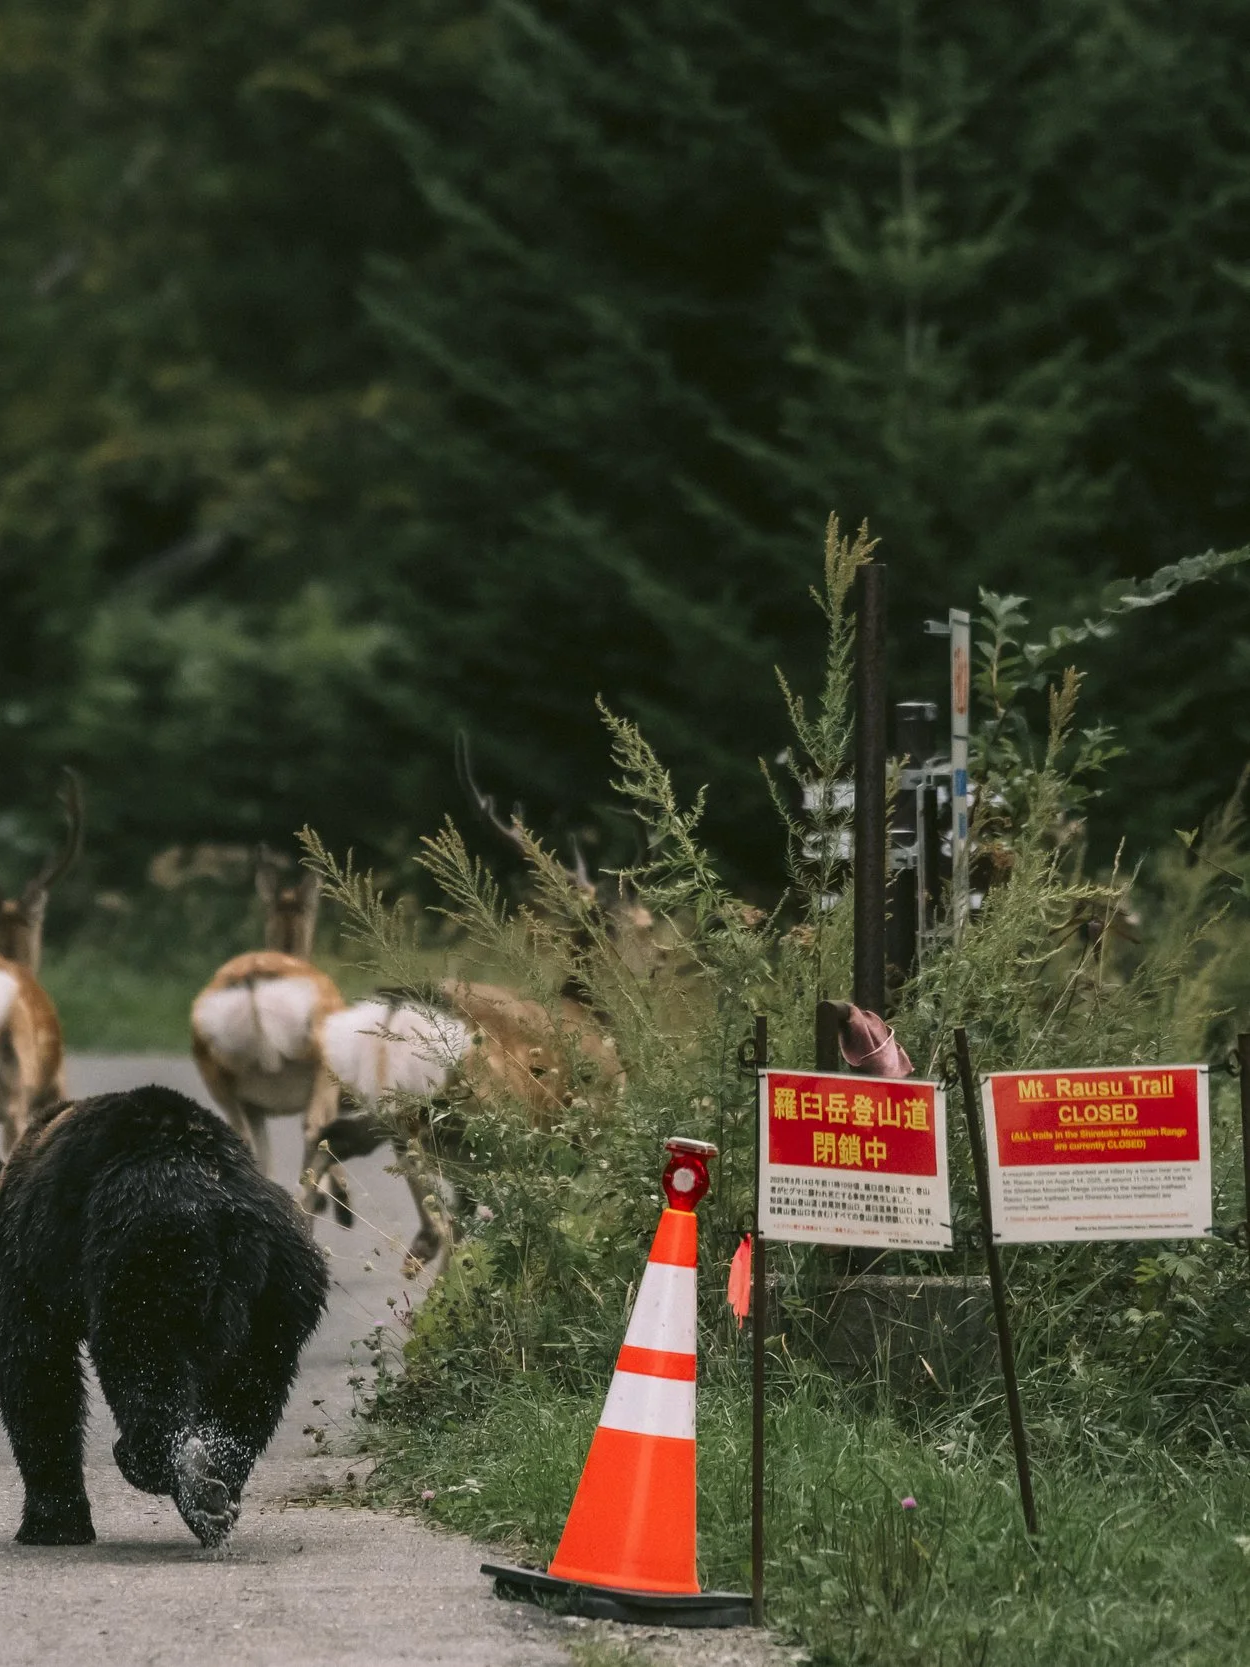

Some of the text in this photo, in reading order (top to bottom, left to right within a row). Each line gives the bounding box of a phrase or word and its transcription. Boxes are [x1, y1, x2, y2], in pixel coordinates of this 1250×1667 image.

[1017, 1074, 1174, 1099] Mt. Rausu Trail
[773, 1086, 930, 1131] 羅臼岳登山道
[1058, 1103, 1139, 1124] CLOSED
[1010, 1130, 1031, 1142] (ALL
[1032, 1130, 1053, 1140] trails
[1054, 1130, 1063, 1140] in
[1064, 1129, 1079, 1139] the
[1120, 1127, 1159, 1137] Mountain
[1160, 1126, 1188, 1138] Range
[1054, 1138, 1146, 1152] are currently CLOSED)
[812, 1131, 887, 1169] 閉鎖中
